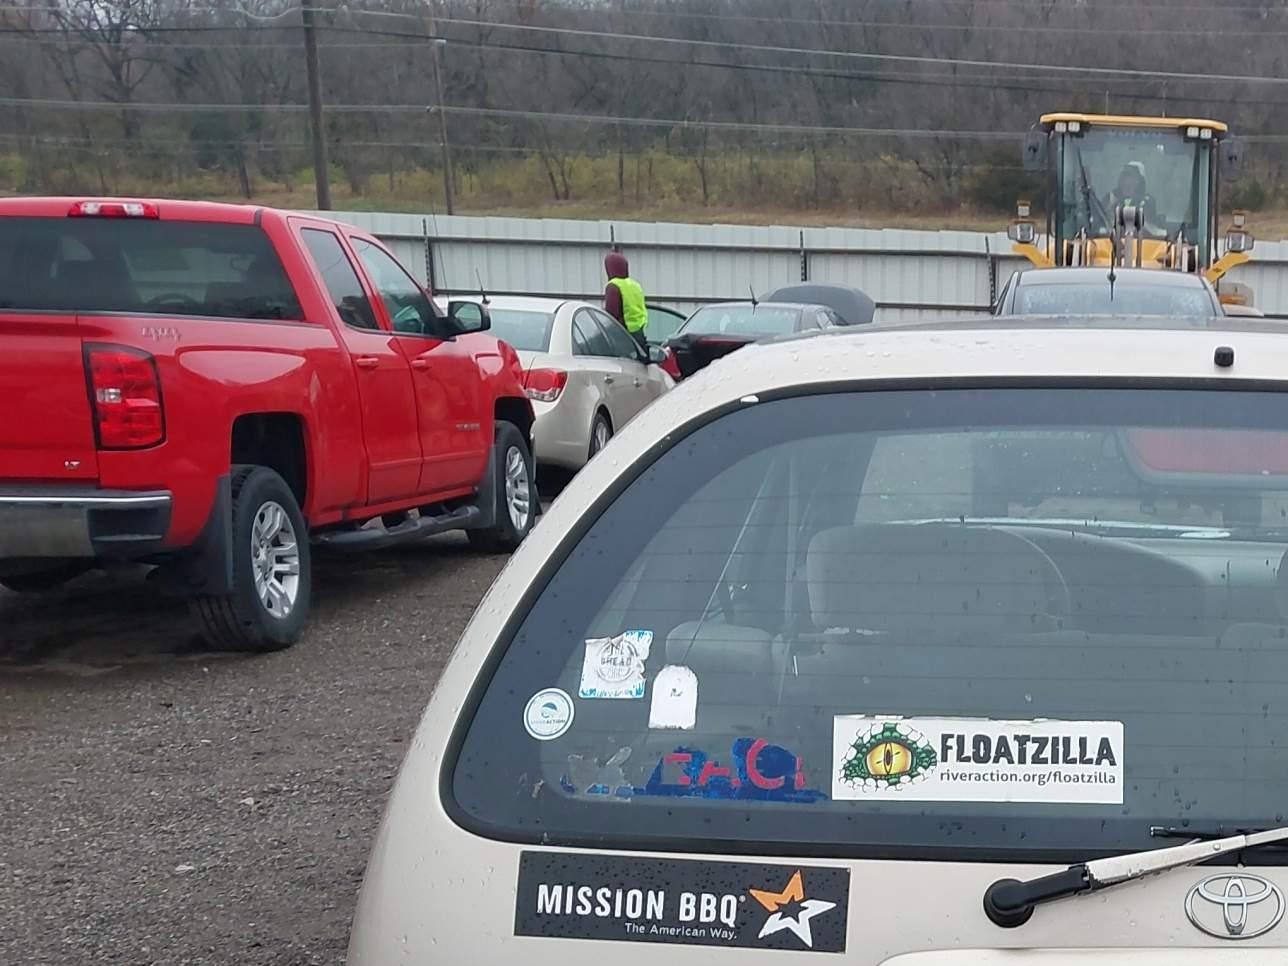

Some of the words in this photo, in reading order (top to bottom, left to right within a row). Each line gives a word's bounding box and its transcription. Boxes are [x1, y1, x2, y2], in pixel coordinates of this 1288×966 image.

[940, 733, 1117, 766] FLOATZILLA
[940, 769, 1116, 786] riveraction.org/floatzilla
[536, 883, 665, 920] MISSION
[624, 922, 646, 934] The
[649, 923, 706, 938] American
[709, 927, 738, 940] Way.
